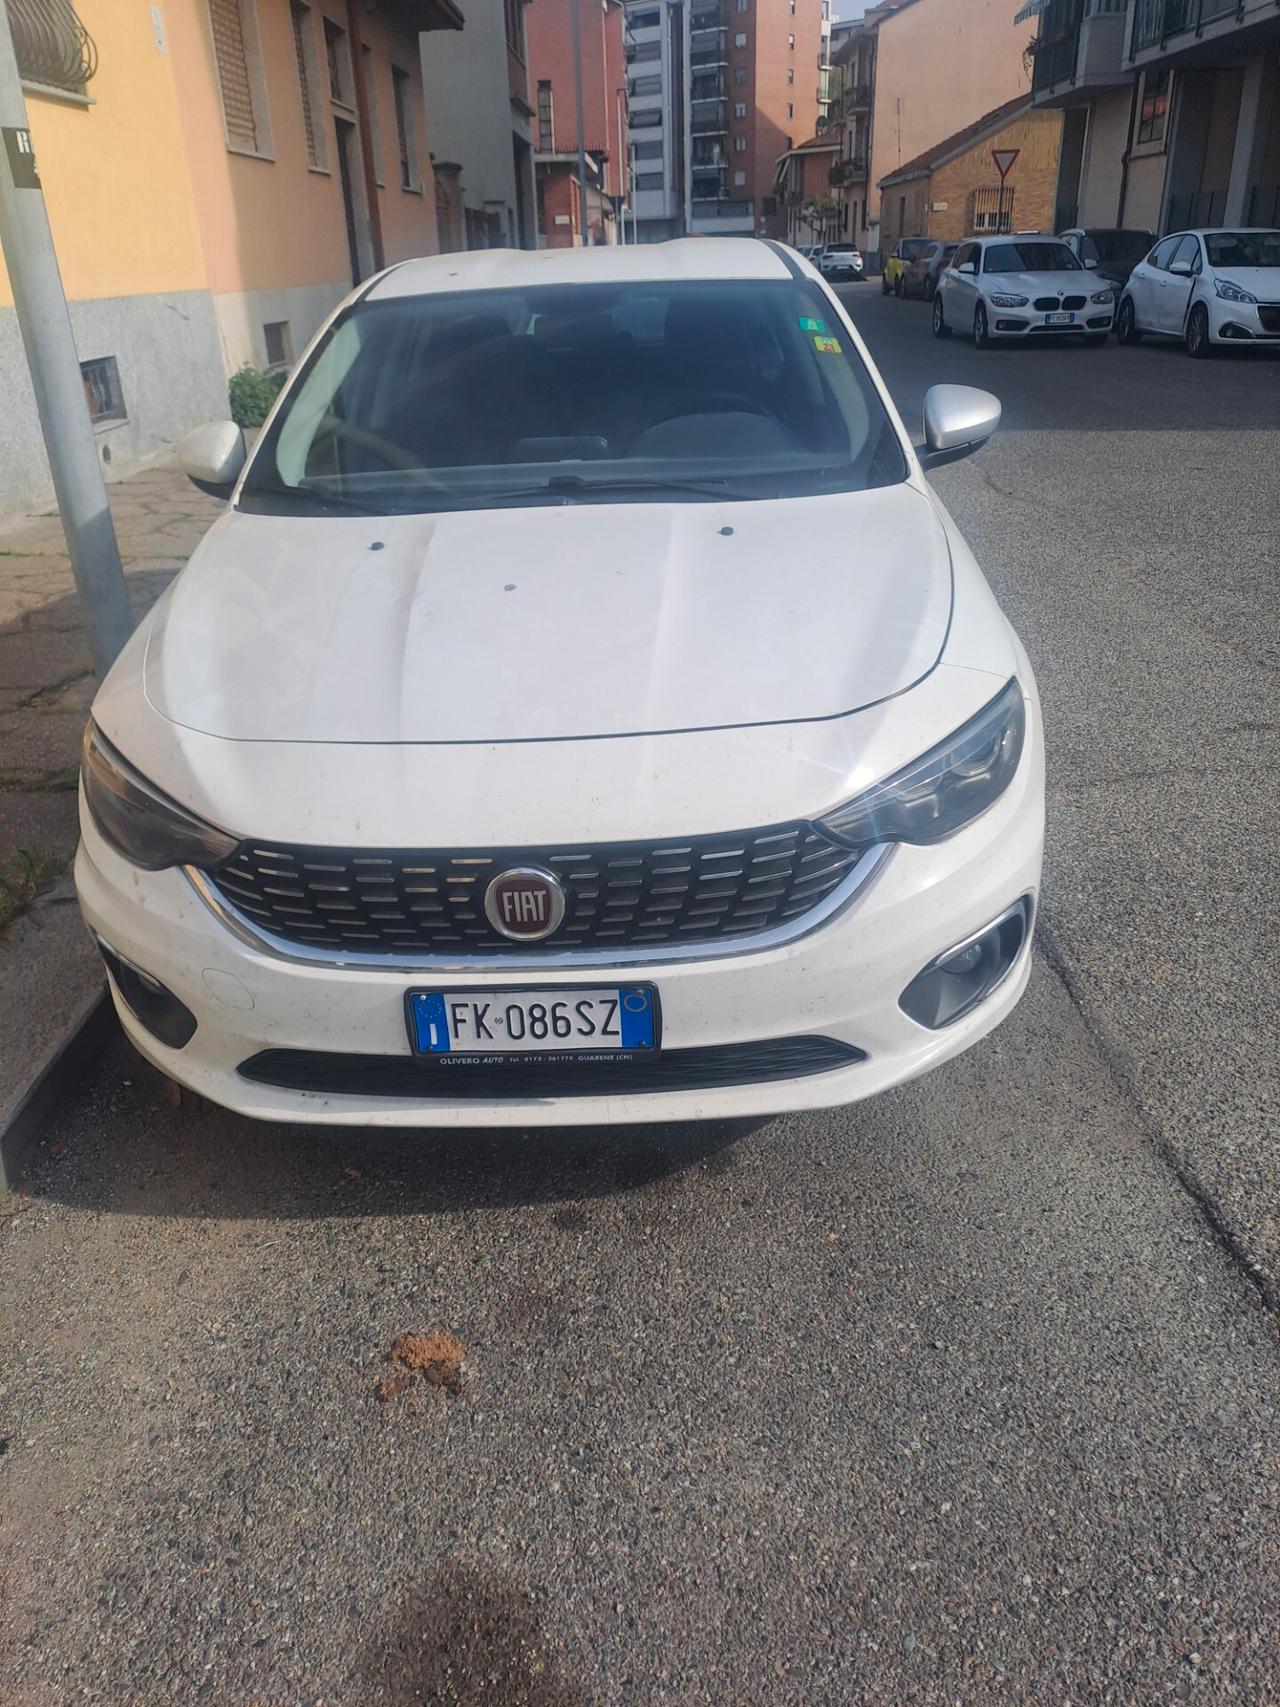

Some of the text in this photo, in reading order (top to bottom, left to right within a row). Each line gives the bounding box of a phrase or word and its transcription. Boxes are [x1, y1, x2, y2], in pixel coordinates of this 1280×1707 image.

[502, 890, 547, 922] FIAT
[440, 1057, 480, 1065] OLIVERO
[482, 1056, 504, 1064] AUTO
